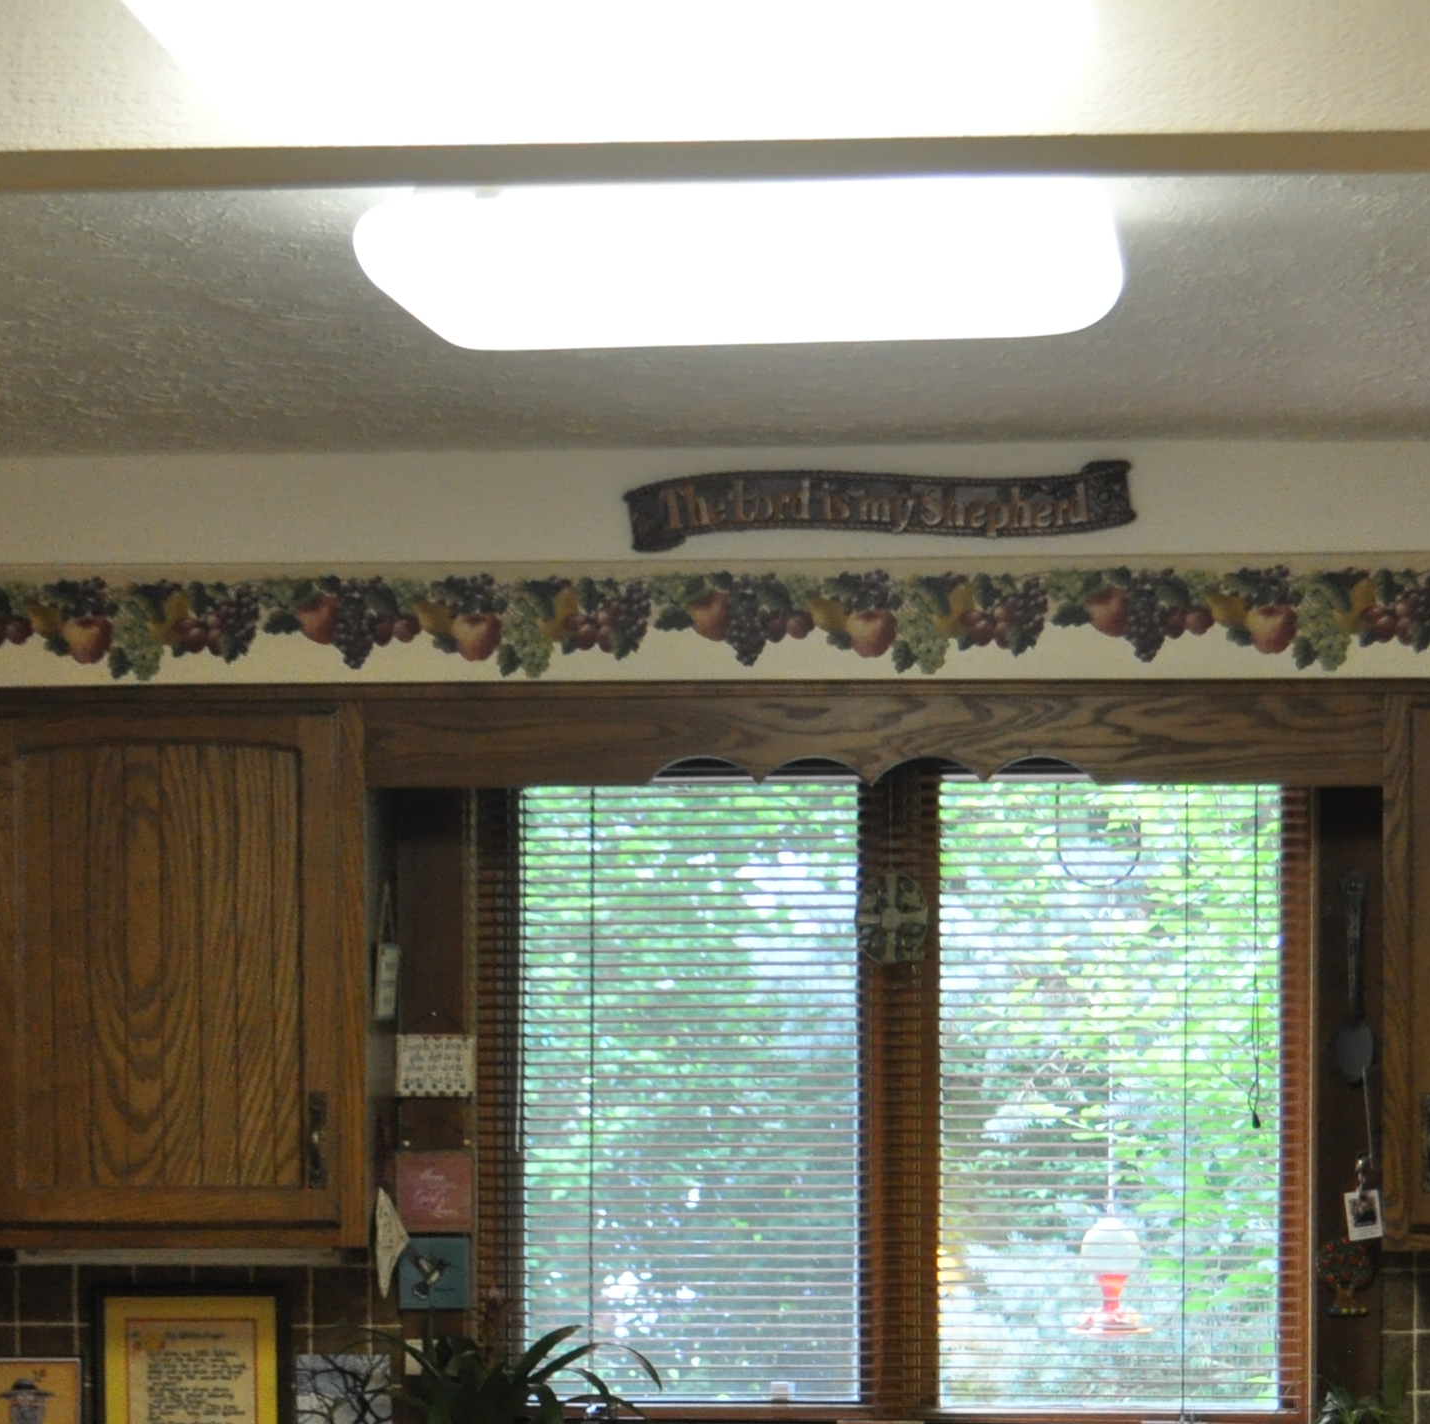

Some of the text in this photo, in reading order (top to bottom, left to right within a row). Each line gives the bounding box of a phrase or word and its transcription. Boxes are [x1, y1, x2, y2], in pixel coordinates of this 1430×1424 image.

[662, 480, 1089, 538] The Lord is my Shepherd
